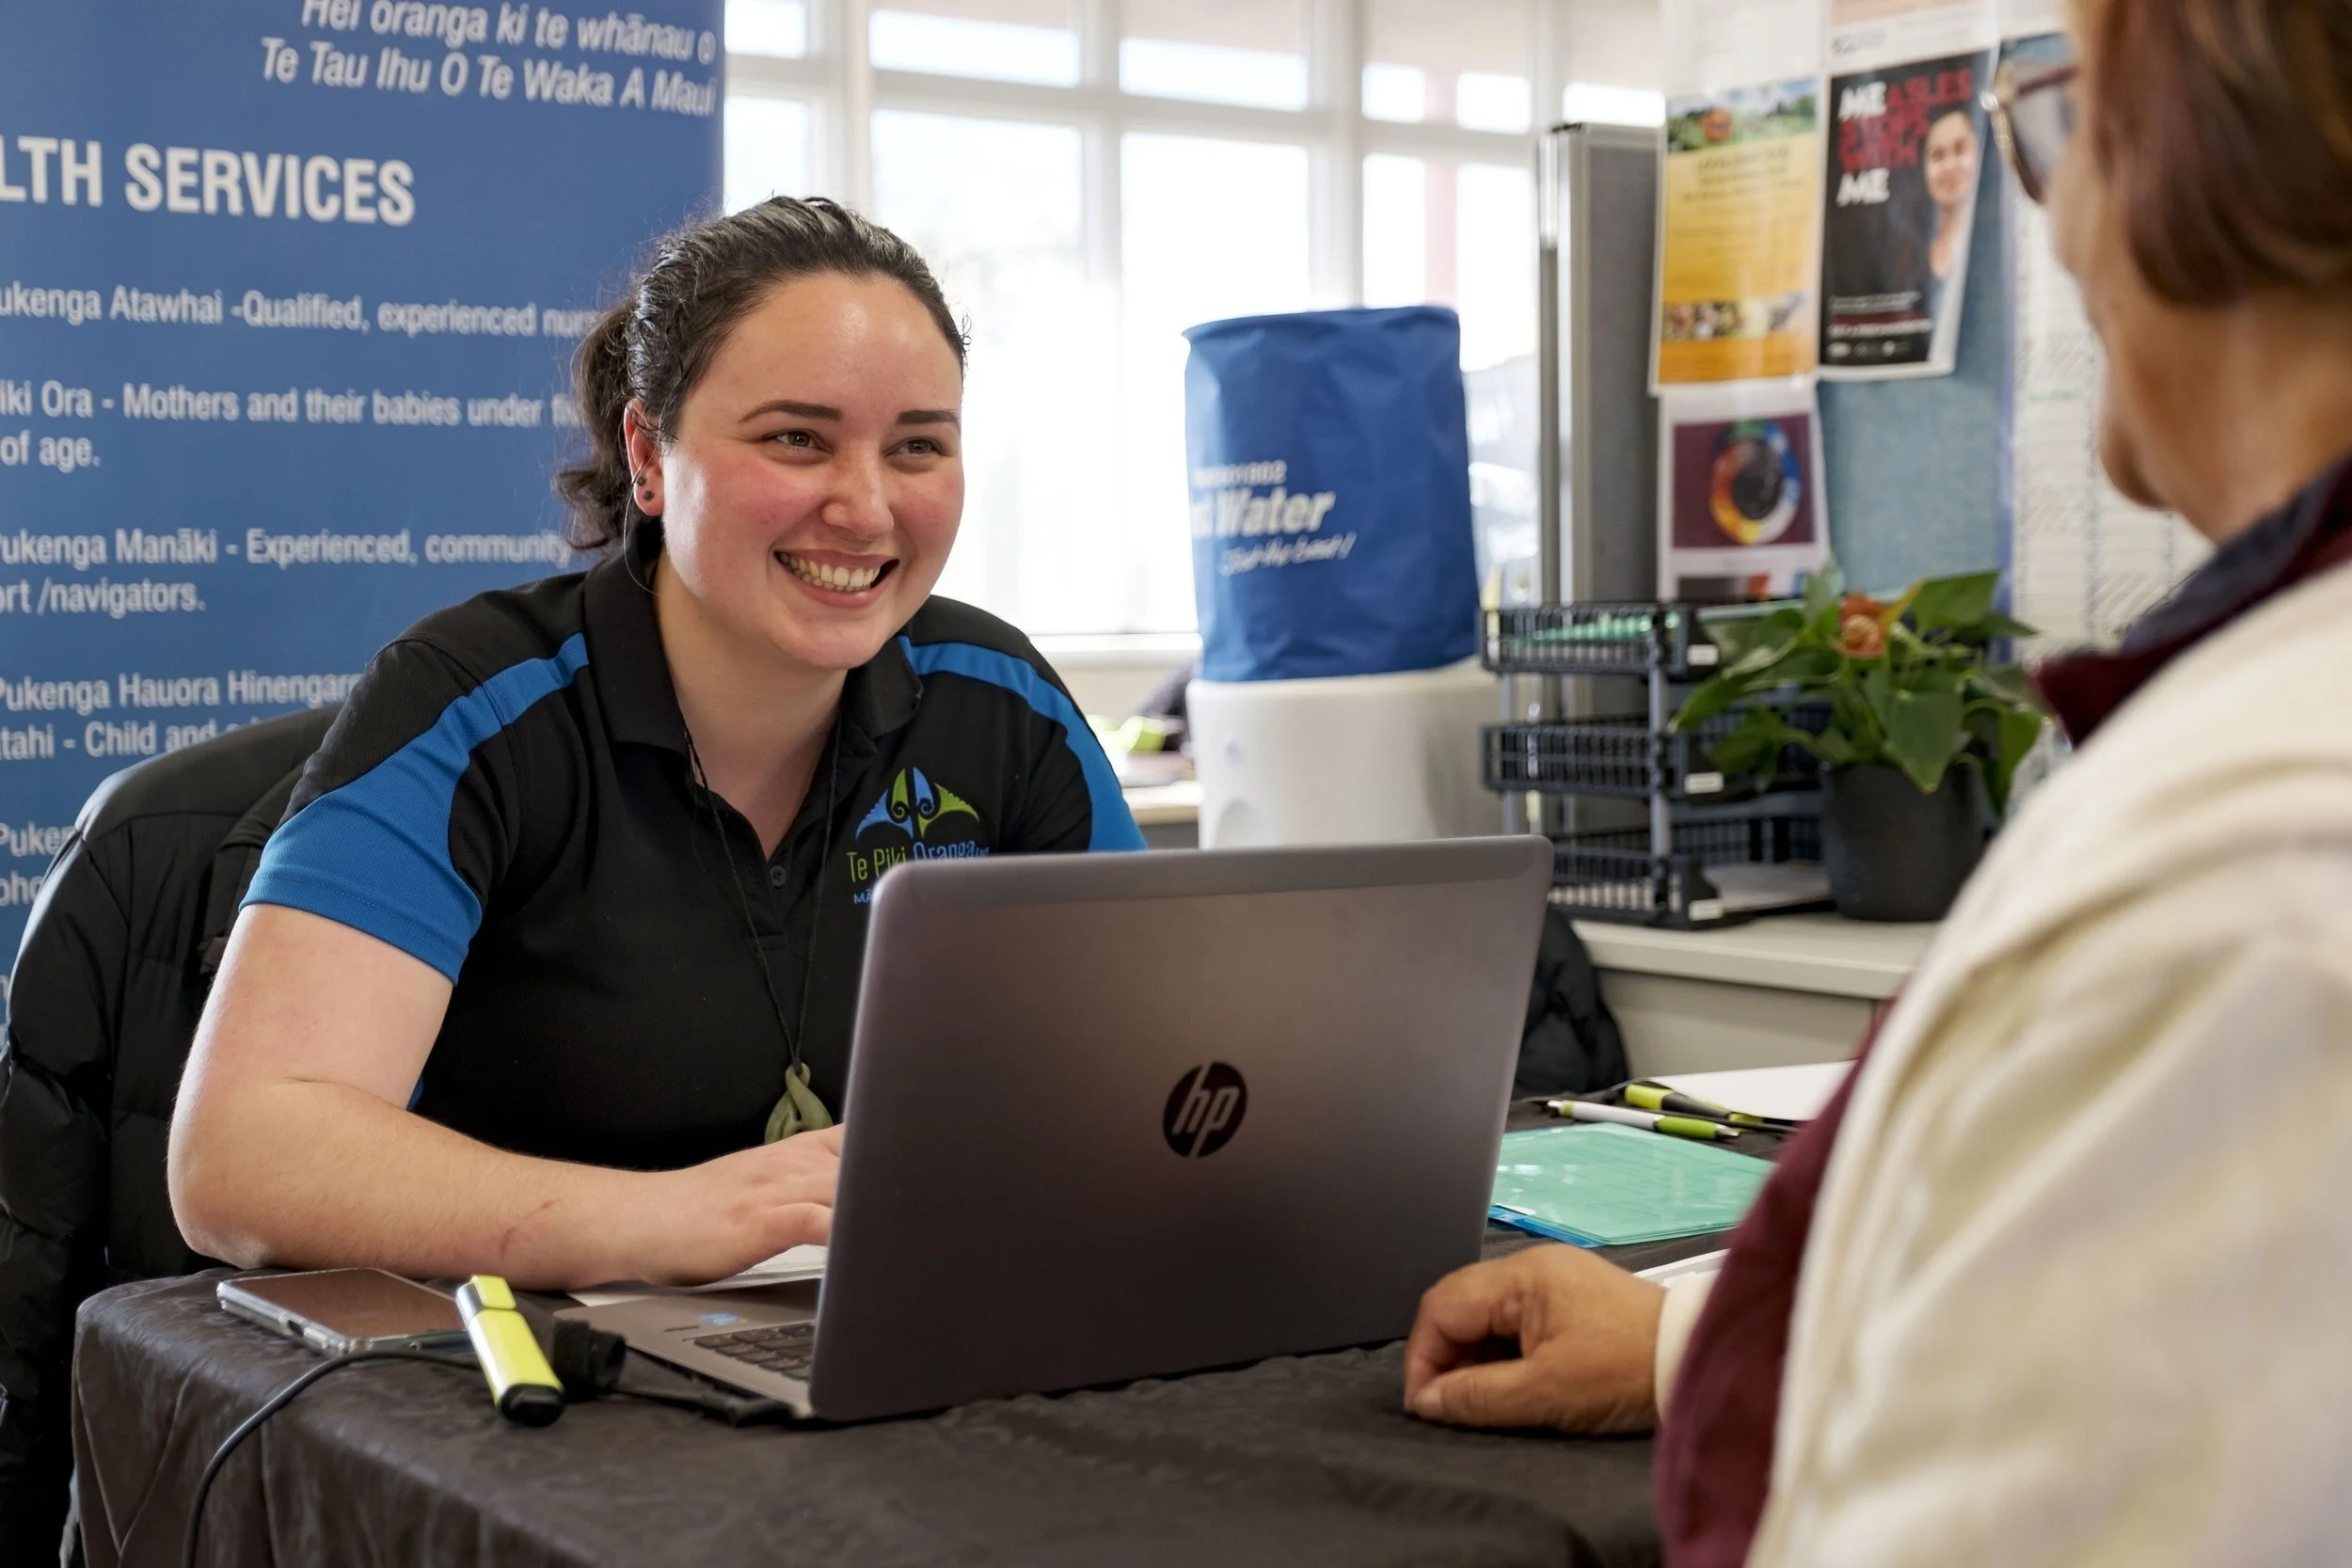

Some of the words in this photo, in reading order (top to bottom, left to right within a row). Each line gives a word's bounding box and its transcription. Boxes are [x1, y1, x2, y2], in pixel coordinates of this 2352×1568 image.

[370, 0, 488, 50] oranga
[496, 1, 530, 45] ki
[534, 6, 569, 50] te
[577, 9, 695, 61] whānau
[697, 29, 716, 65] o
[261, 36, 299, 83] Te
[309, 40, 369, 88] Tau
[376, 47, 432, 93] Ihu
[439, 51, 469, 97] O
[477, 55, 514, 101] Te
[523, 57, 614, 107] Waka
[619, 66, 645, 109] A
[651, 69, 718, 117] Maui
[1839, 69, 1974, 119] MEASLES
[124, 142, 416, 227] SERVICES
[1836, 166, 1891, 207] ME
[110, 284, 223, 325] Atawhai
[377, 298, 537, 340] experienced
[41, 379, 93, 419] Ora
[122, 381, 240, 421] Mothers
[247, 387, 299, 423] and
[304, 388, 367, 424] their
[372, 388, 462, 426] babies
[467, 391, 544, 428] under
[0, 429, 31, 467] of
[39, 436, 101, 473] age.
[1216, 485, 1336, 537] Water
[0, 527, 107, 572] ukenga
[115, 527, 219, 564] Manāki
[246, 528, 419, 571] Experienced,
[424, 529, 570, 569] community
[119, 672, 220, 707] Hauora
[0, 723, 55, 762] tahi
[85, 720, 156, 758] Child
[164, 718, 217, 755] and
[847, 851, 868, 882] Te
[873, 846, 907, 879] Piki
[1166, 1061, 1244, 1159] hp
